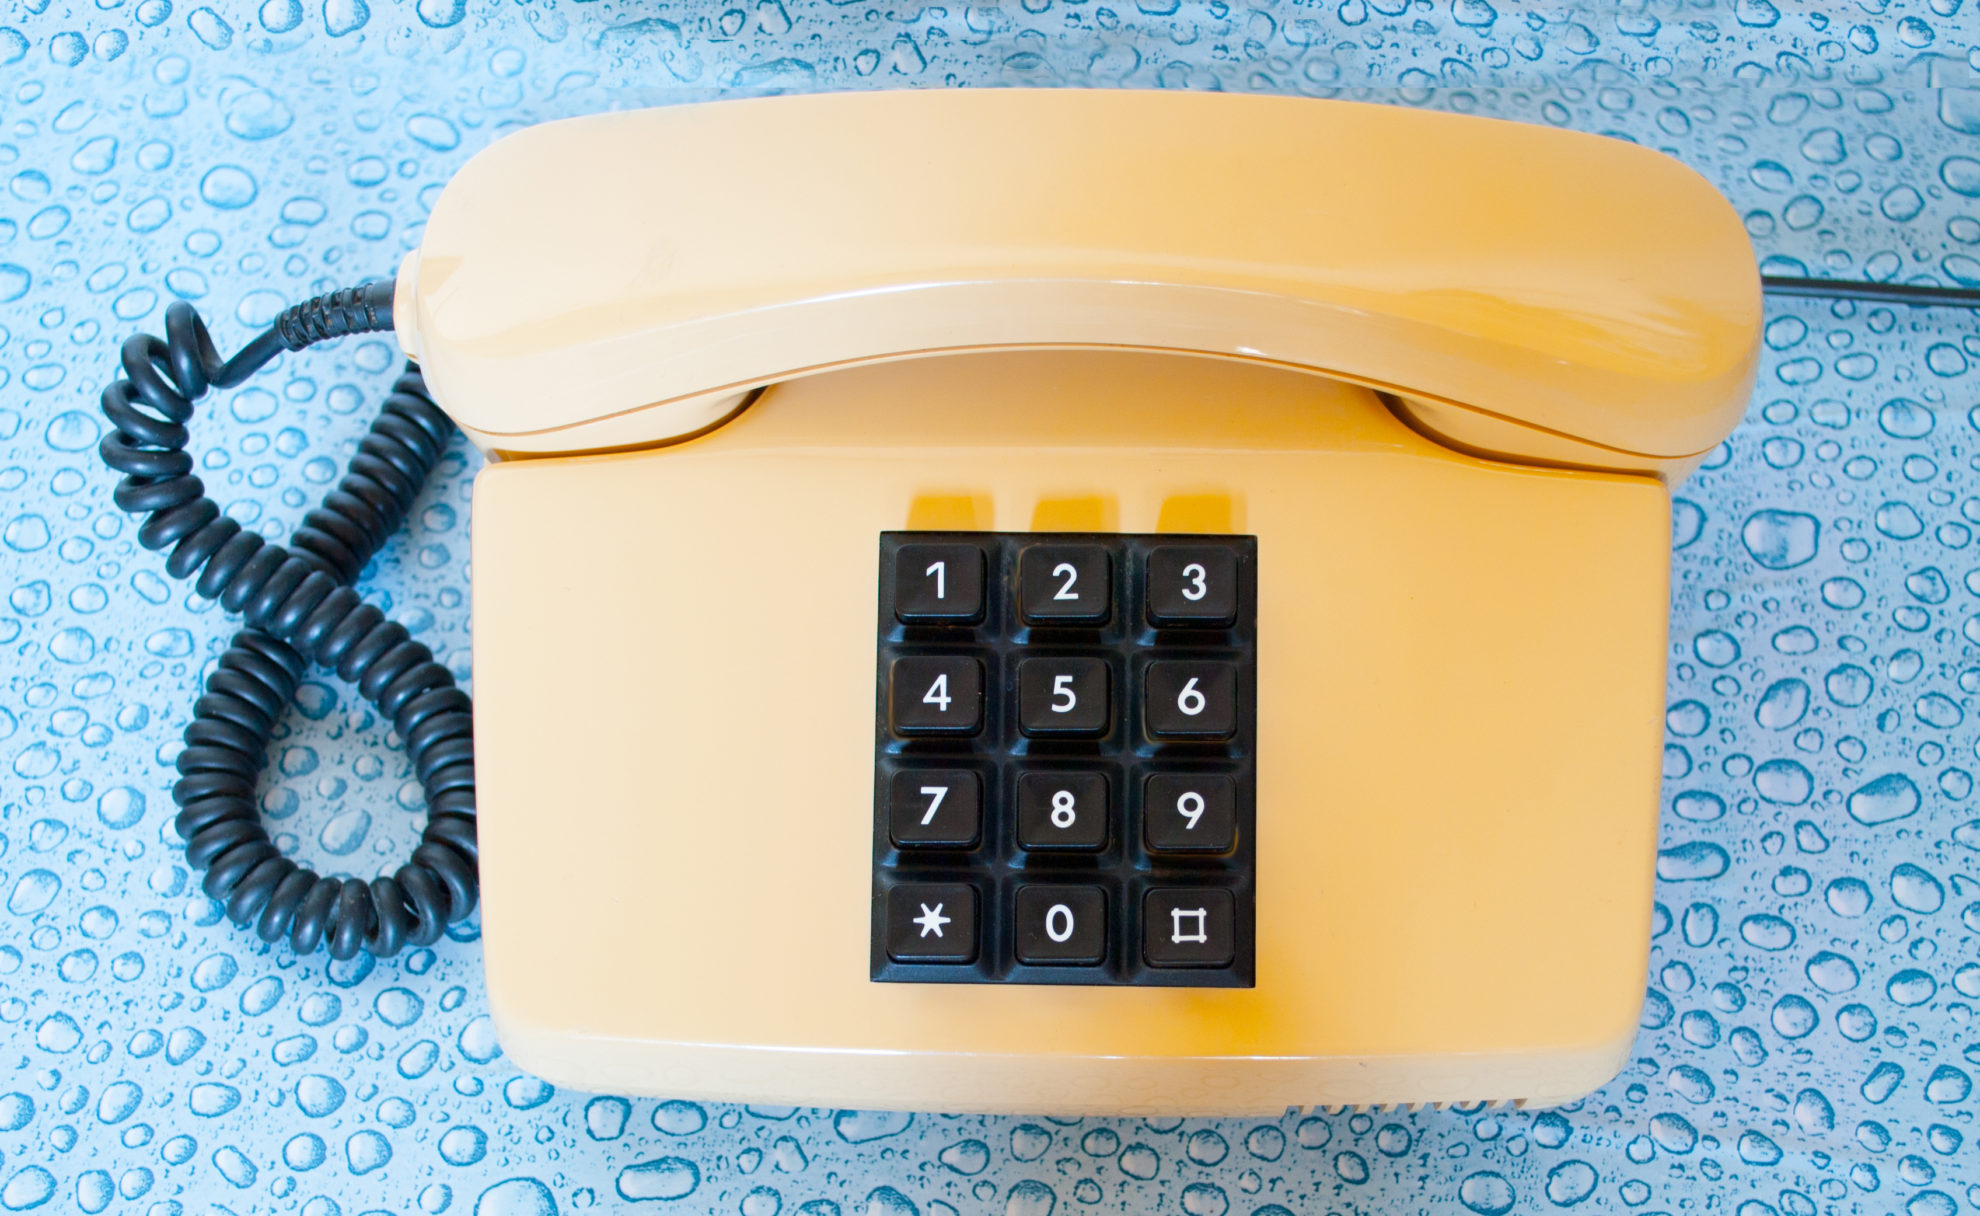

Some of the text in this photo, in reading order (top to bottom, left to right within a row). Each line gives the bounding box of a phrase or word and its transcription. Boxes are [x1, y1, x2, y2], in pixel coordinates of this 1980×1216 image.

[925, 561, 1207, 601] 1 2 3
[922, 673, 1206, 716] 4 5 6
[920, 786, 1205, 830] 7 8 9
[1045, 904, 1074, 943] 0
